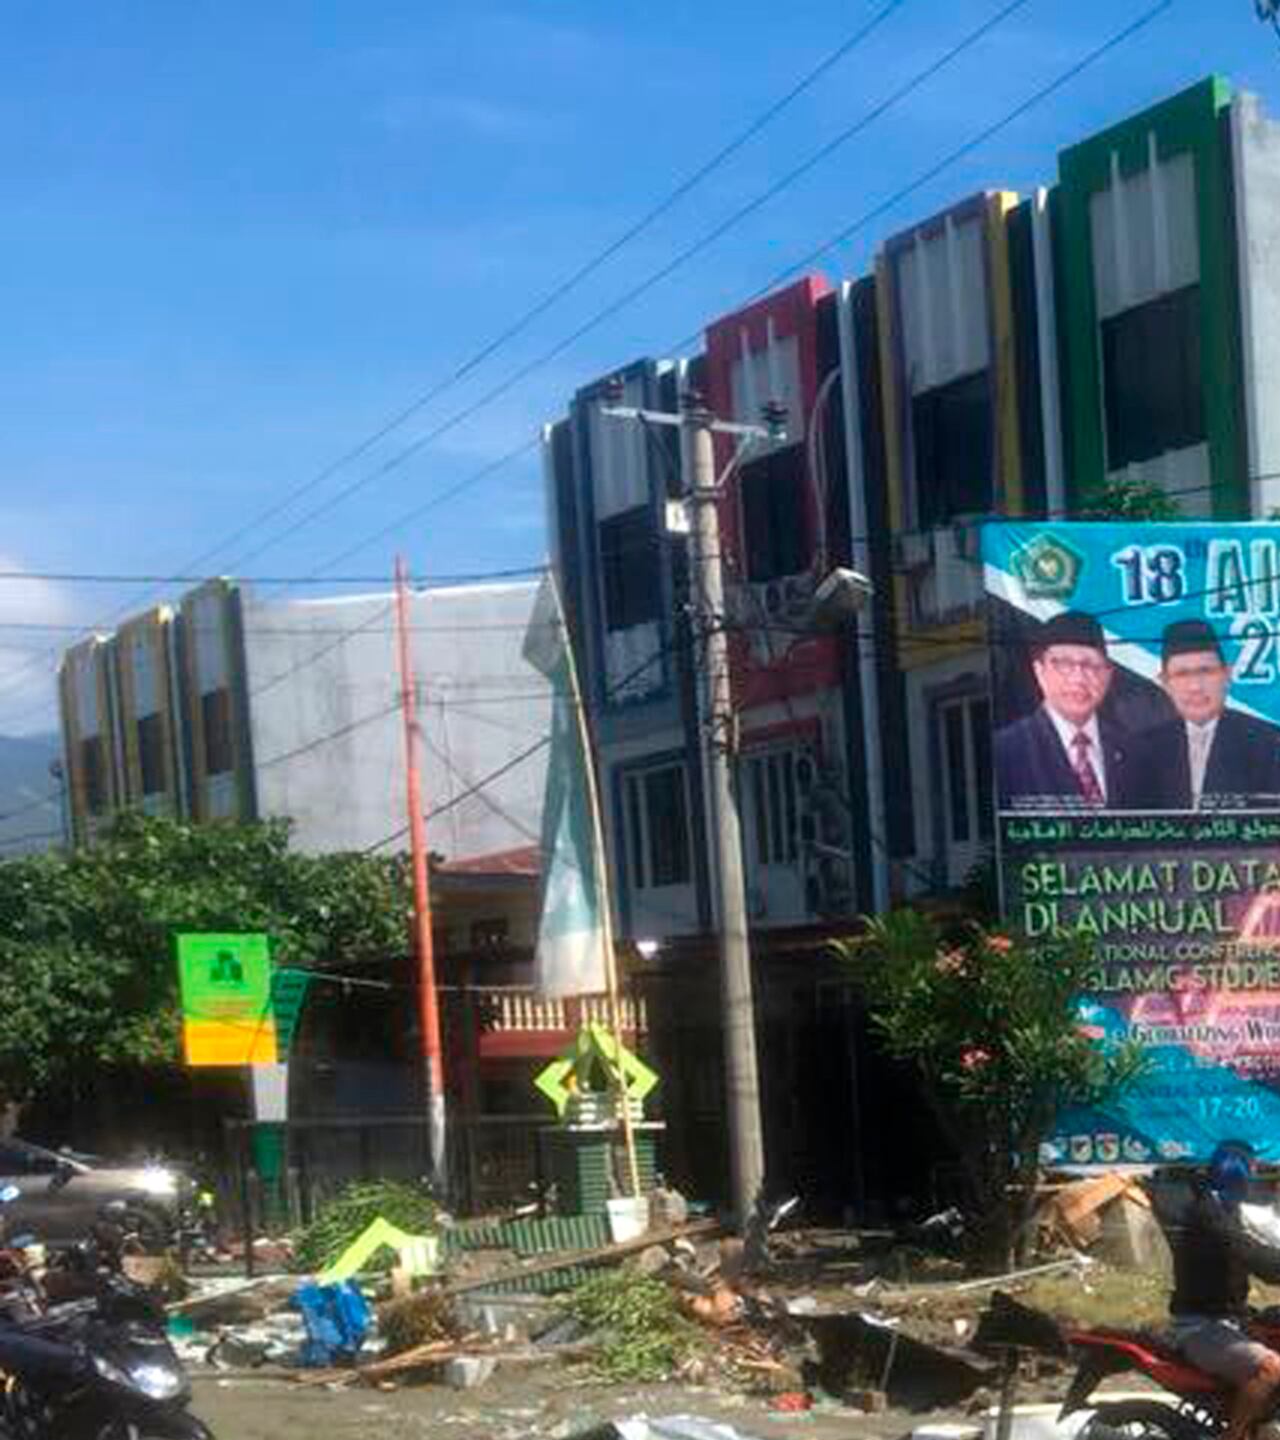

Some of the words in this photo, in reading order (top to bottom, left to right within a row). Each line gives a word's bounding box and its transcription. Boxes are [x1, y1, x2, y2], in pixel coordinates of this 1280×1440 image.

[1113, 544, 1186, 606] 18
[1022, 861, 1180, 896] SELAMAT
[1076, 902, 1235, 935] ANNUAL
